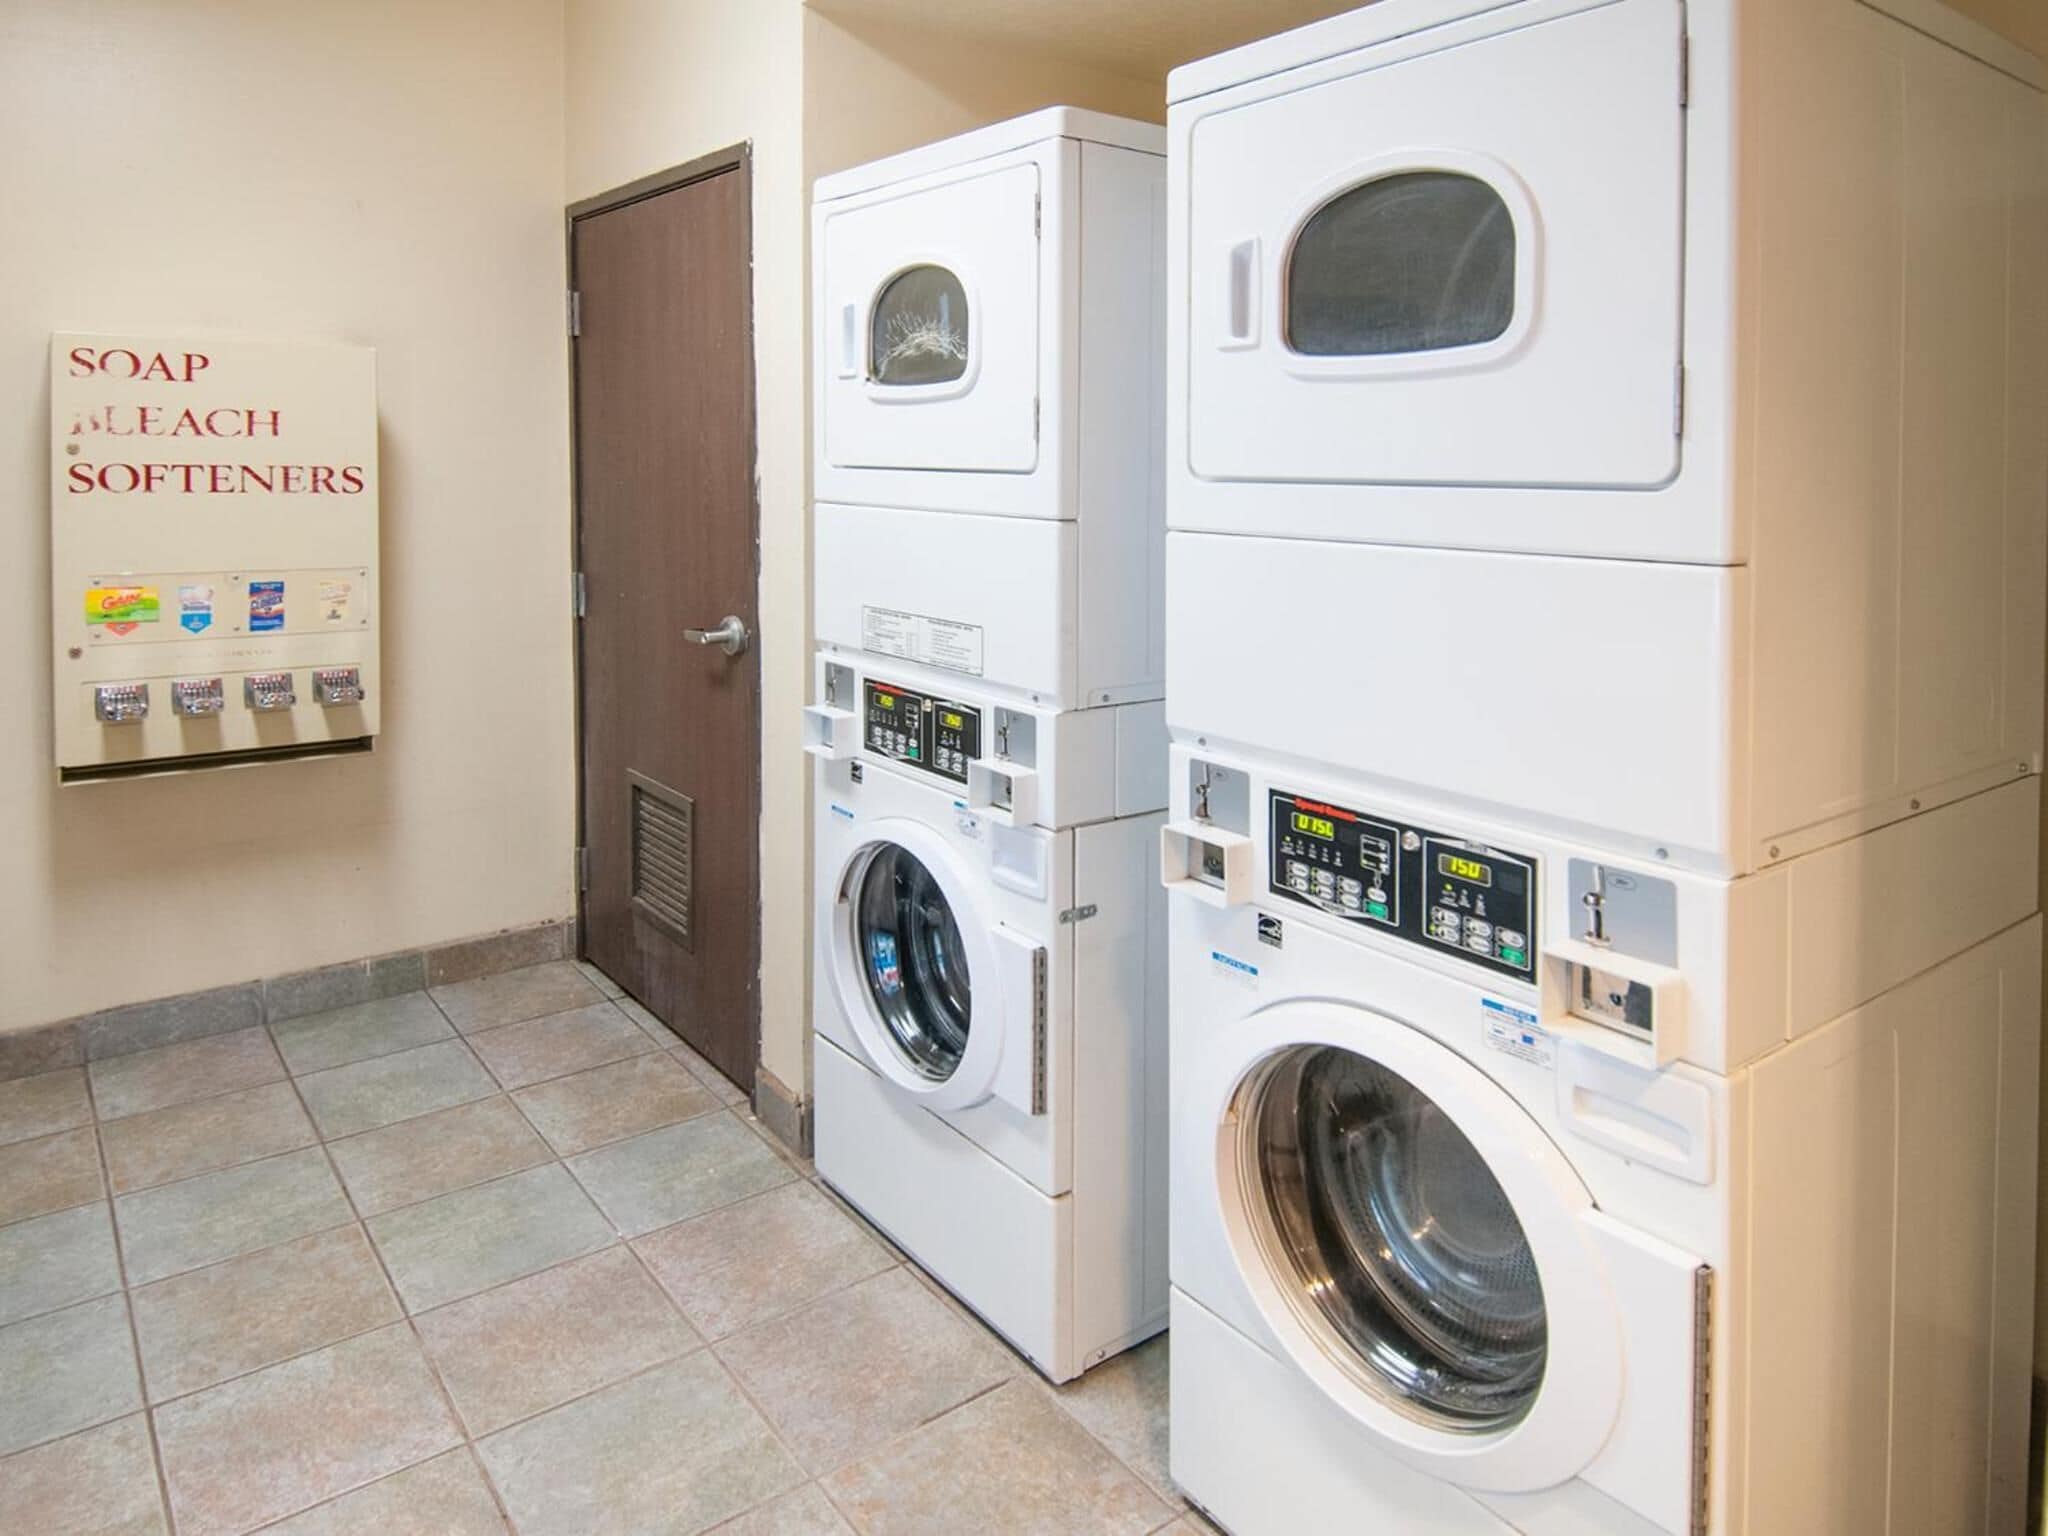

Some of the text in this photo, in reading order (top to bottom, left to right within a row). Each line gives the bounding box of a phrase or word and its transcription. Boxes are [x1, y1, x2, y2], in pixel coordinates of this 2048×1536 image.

[69, 347, 210, 383] SOAP
[68, 462, 365, 494] SOFTENERS
[1450, 857, 1481, 879] 150
